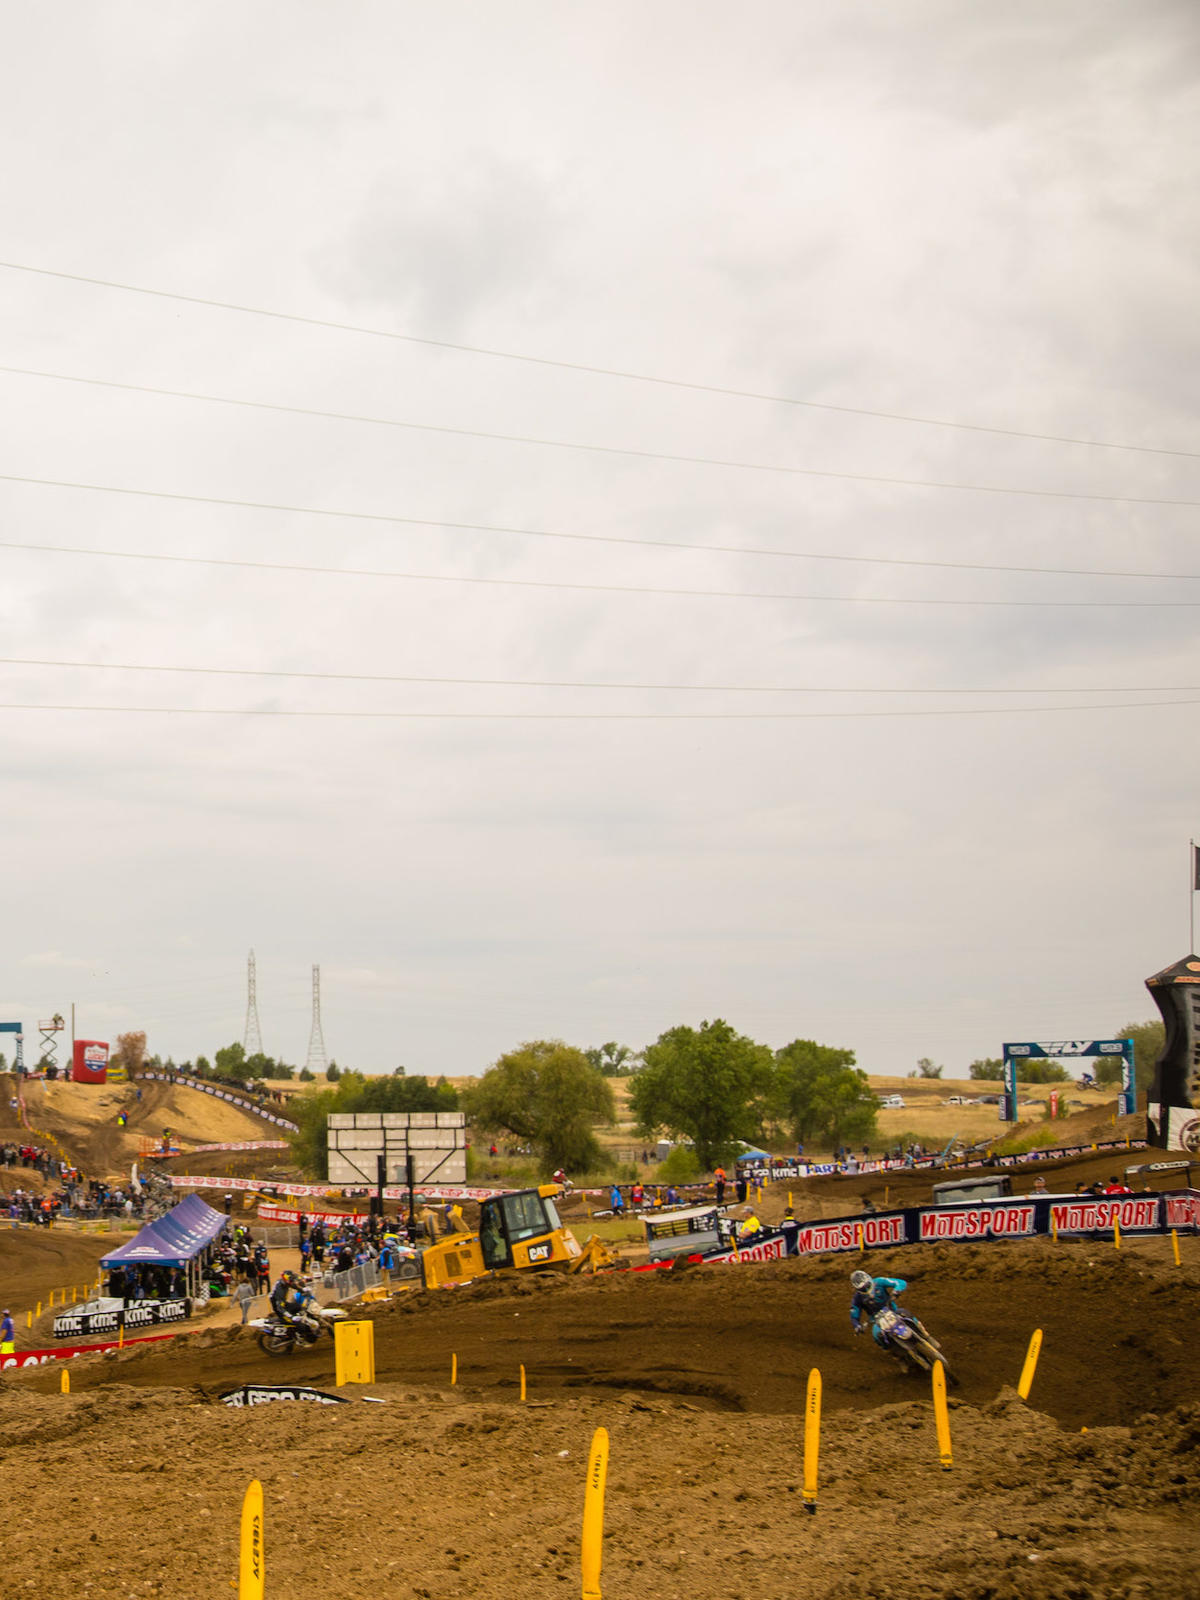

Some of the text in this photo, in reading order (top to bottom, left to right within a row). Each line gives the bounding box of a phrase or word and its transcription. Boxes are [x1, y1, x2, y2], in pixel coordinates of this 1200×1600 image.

[772, 1167, 798, 1178] KMC
[529, 1246, 548, 1260] CAT
[54, 1317, 83, 1331] KMC
[89, 1313, 118, 1328] KMC
[124, 1308, 153, 1323] KMC
[159, 1302, 185, 1317] KMC
